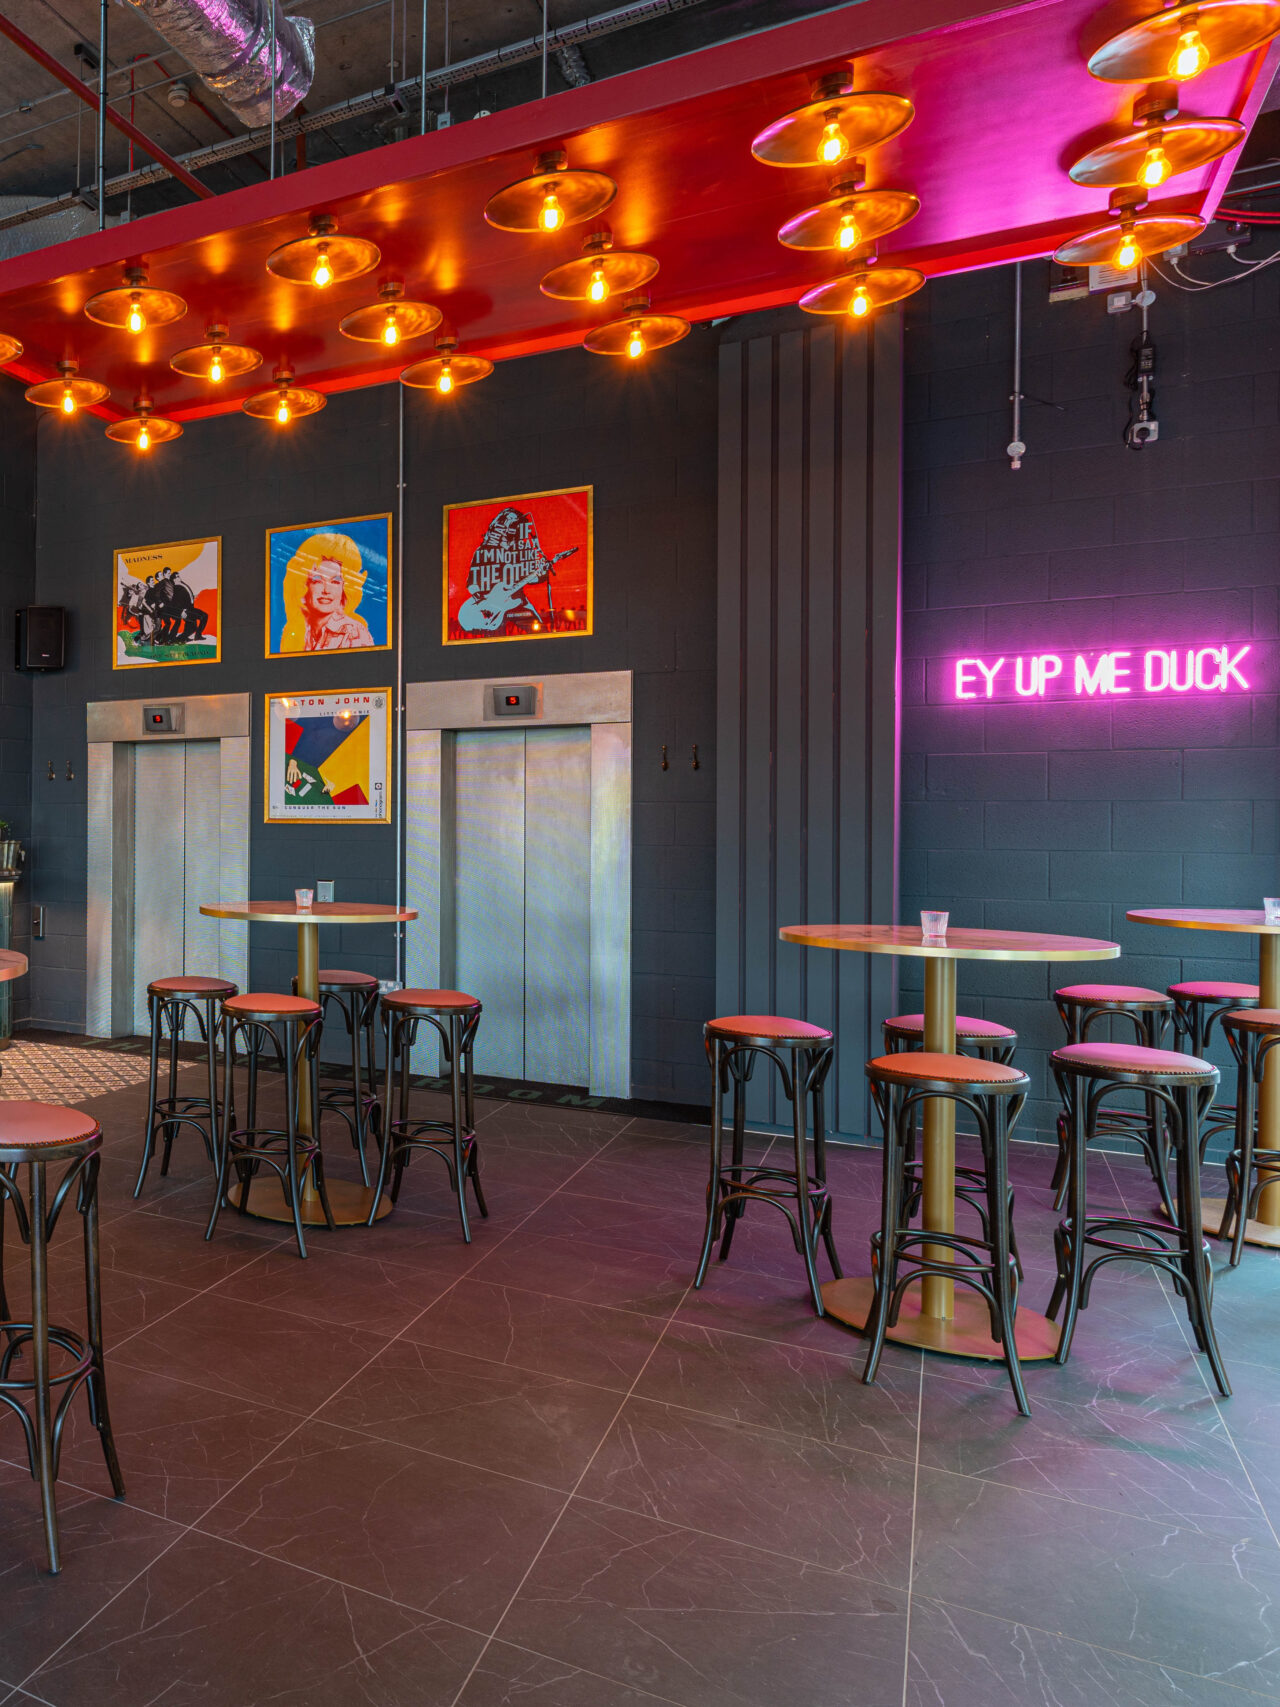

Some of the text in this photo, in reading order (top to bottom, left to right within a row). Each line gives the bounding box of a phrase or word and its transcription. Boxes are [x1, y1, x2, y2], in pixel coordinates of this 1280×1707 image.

[488, 522, 507, 547] WHAT
[520, 522, 534, 540] IF
[518, 537, 539, 550] SAY
[125, 554, 163, 564] MADNESS
[476, 548, 541, 564] I'M NOT LIKE
[470, 564, 500, 592] THE
[956, 644, 1251, 699] EY UP ME DUCK
[283, 696, 370, 707] LTON JOHN
